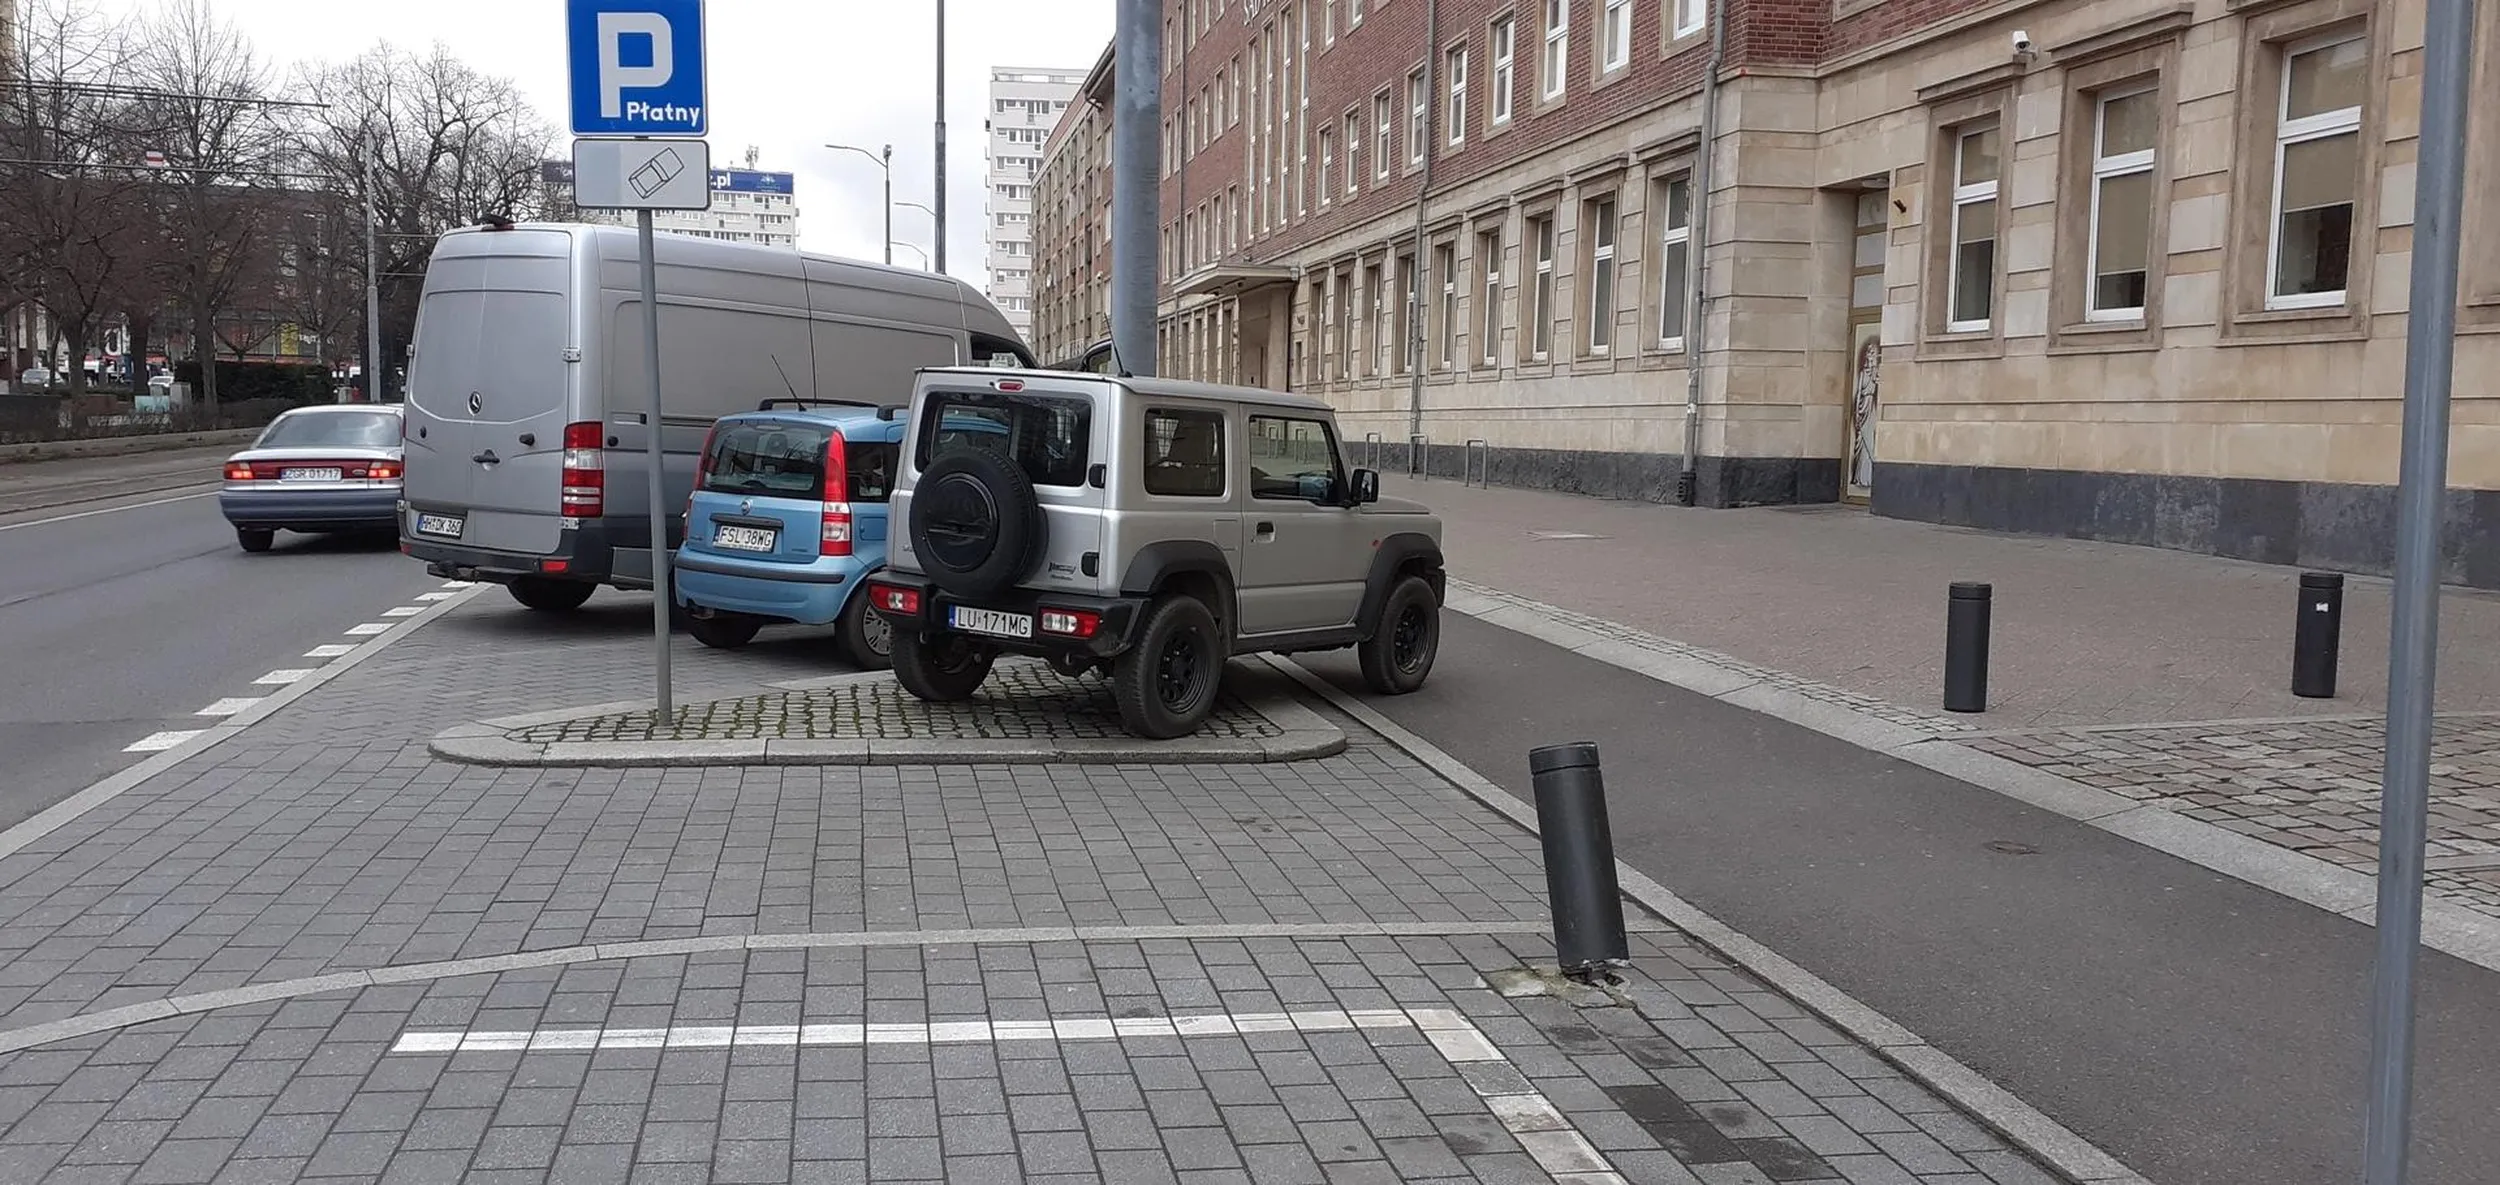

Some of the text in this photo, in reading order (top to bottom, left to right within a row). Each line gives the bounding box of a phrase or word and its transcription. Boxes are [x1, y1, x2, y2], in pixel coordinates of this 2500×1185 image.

[597, 12, 673, 118] P
[626, 101, 700, 127] Płatny
[710, 172, 732, 188] .pl
[309, 466, 341, 478] 01717
[720, 527, 741, 544] FSL
[744, 529, 773, 547] 38WG
[958, 607, 1029, 636] LU 171MG
